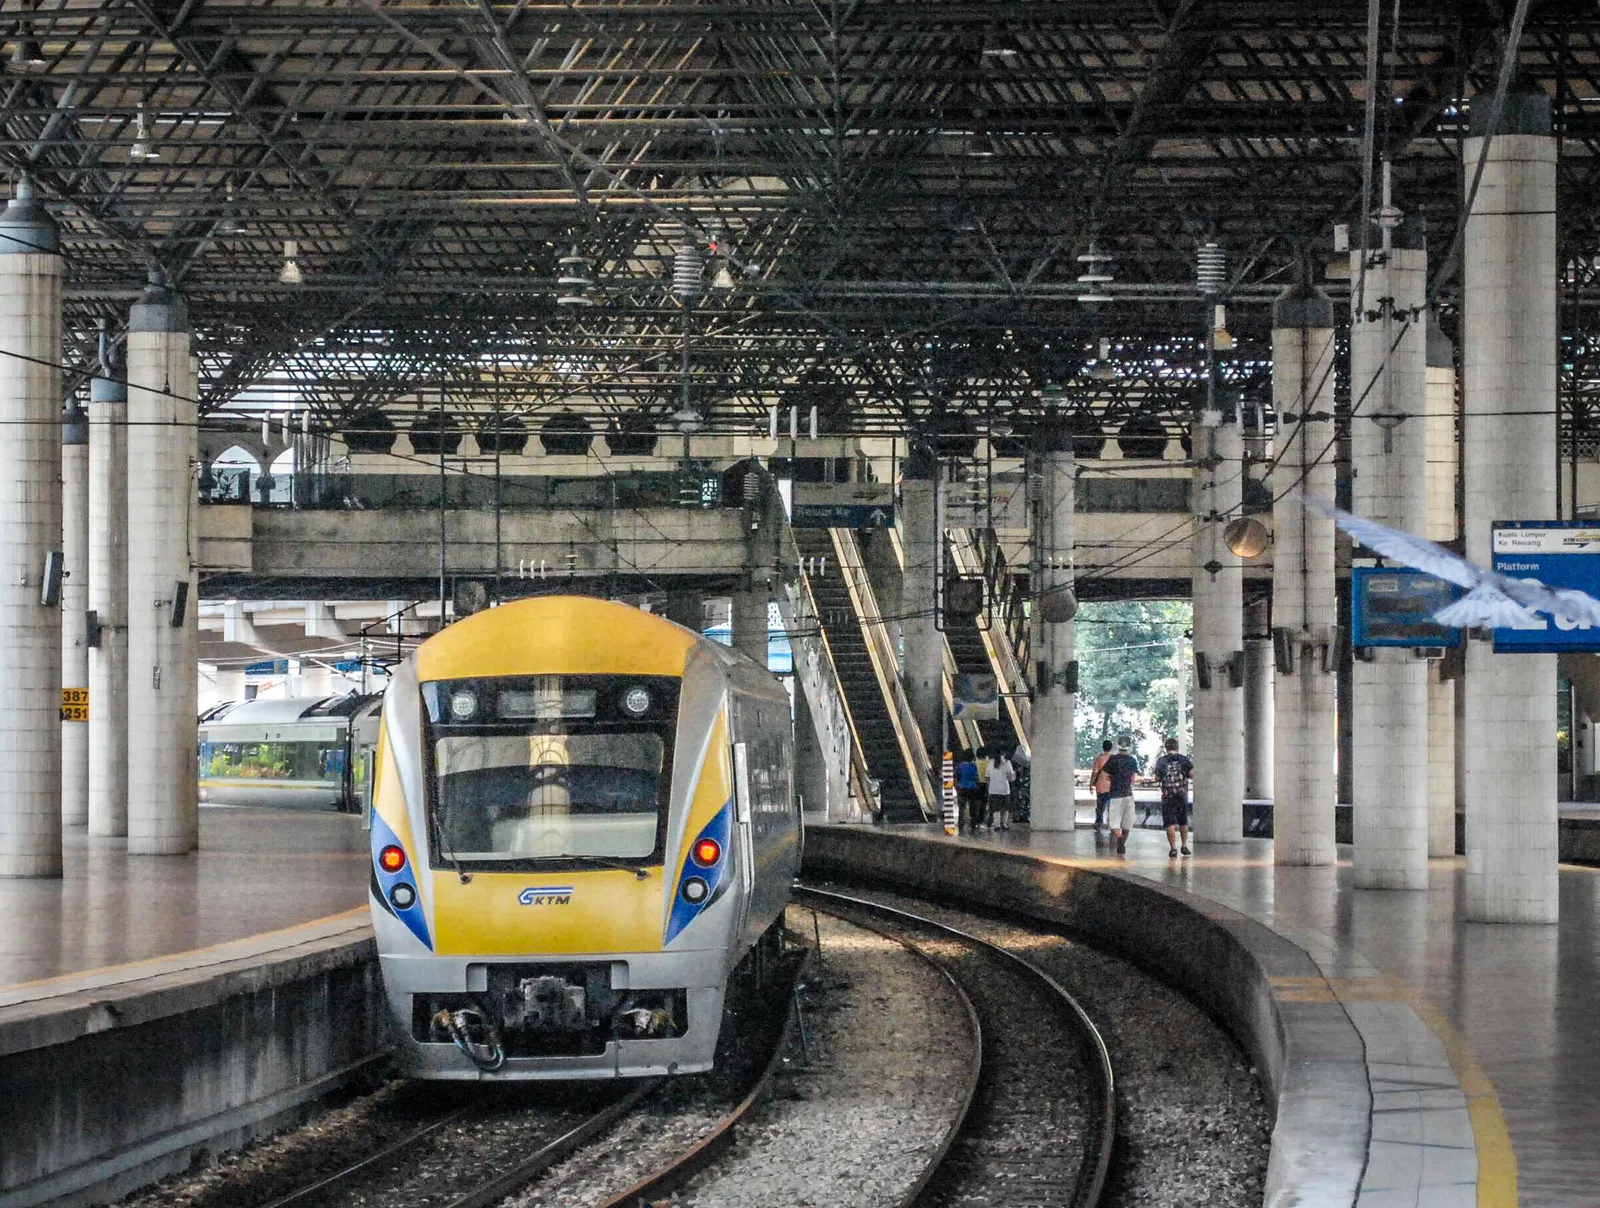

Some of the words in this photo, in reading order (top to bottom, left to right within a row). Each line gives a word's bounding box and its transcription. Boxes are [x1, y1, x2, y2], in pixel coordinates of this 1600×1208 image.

[1520, 531, 1547, 539] Lumpur
[1511, 540, 1542, 548] Rawang
[1497, 562, 1540, 571] Platform
[63, 690, 89, 702] 387
[534, 895, 571, 906] KTM
